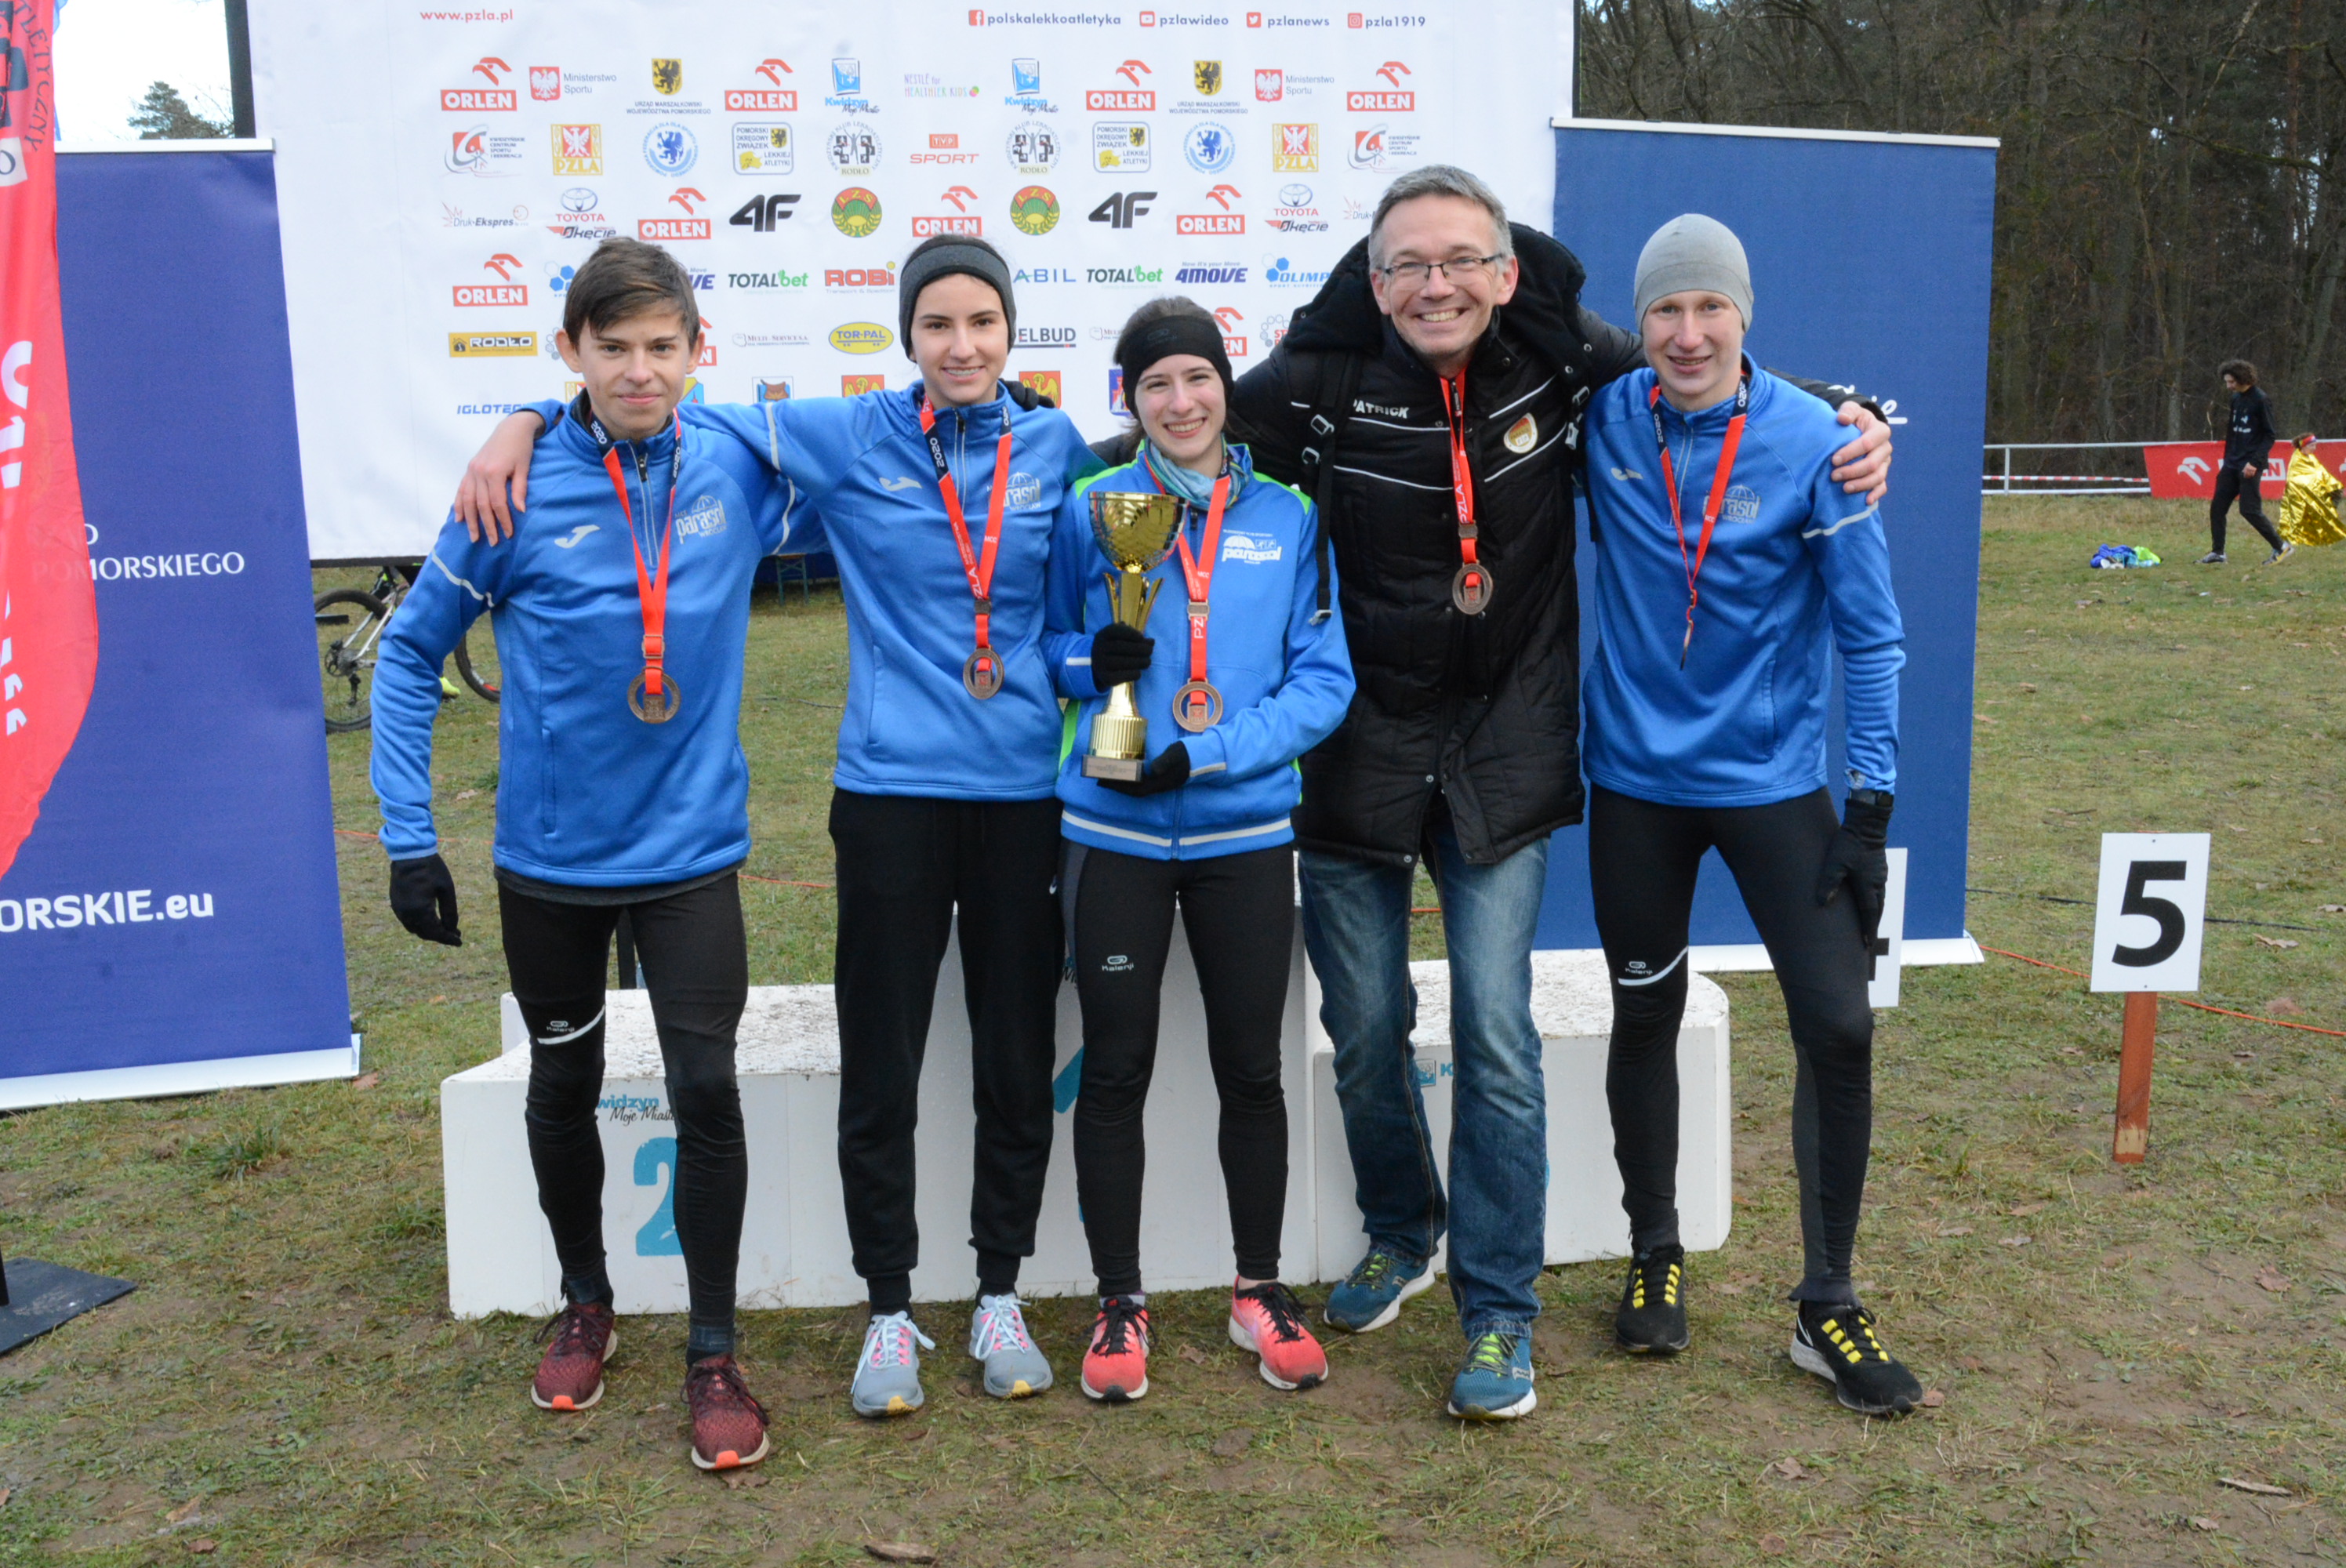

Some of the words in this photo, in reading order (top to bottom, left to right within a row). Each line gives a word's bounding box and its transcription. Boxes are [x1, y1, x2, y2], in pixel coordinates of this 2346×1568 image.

[420, 9, 514, 23] www.pzla.pl
[987, 13, 1121, 26] polskalekkoatletyka
[1160, 15, 1229, 27] pzlawideo
[1267, 16, 1330, 27] pzlanews
[1365, 16, 1425, 28] pzla1919
[564, 73, 617, 82] Ministerstwo
[1286, 75, 1335, 84] Ministerstwo
[564, 84, 593, 95] Sportu
[905, 87, 947, 98] HEALTHIER
[950, 87, 968, 98] KIDS
[1286, 86, 1312, 96] Sportu
[445, 93, 513, 109] ORLEN
[728, 93, 794, 109] ORLEN
[825, 96, 869, 108] Kwidzyn
[1004, 96, 1048, 107] Kwidzyn
[1089, 93, 1152, 109] ORLEN
[1349, 93, 1411, 109] ORLEN
[933, 137, 954, 146] TVP
[556, 158, 600, 173] PZLA
[910, 154, 979, 164] SPORT
[1275, 157, 1316, 169] PZLA
[841, 189, 873, 204] LZS
[1017, 187, 1051, 202] LZS
[555, 213, 605, 222] TOYOTA
[729, 194, 801, 232] 4F
[1088, 191, 1158, 229] 4F
[1273, 208, 1319, 216] TOYOTA
[641, 221, 706, 238] ORLEN
[915, 219, 979, 235] ORLEN
[1179, 217, 1241, 233] ORLEN
[728, 269, 808, 289] TOTALbet
[1086, 265, 1164, 284] TOTALbet
[1175, 267, 1248, 283] 4MOVE
[1279, 272, 1331, 283] OLIMP
[456, 288, 524, 304] ORLEN
[456, 404, 525, 415] IGLOTEC
[590, 420, 608, 445] 2020
[929, 437, 946, 468] 2020
[1004, 478, 1041, 508] rasol
[1702, 495, 1761, 519] rasol
[675, 499, 727, 545] parasol
[2111, 860, 2187, 967] 5
[597, 1093, 659, 1112] widzyn
[641, 1105, 675, 1122] Miast
[634, 1137, 685, 1256] 2
